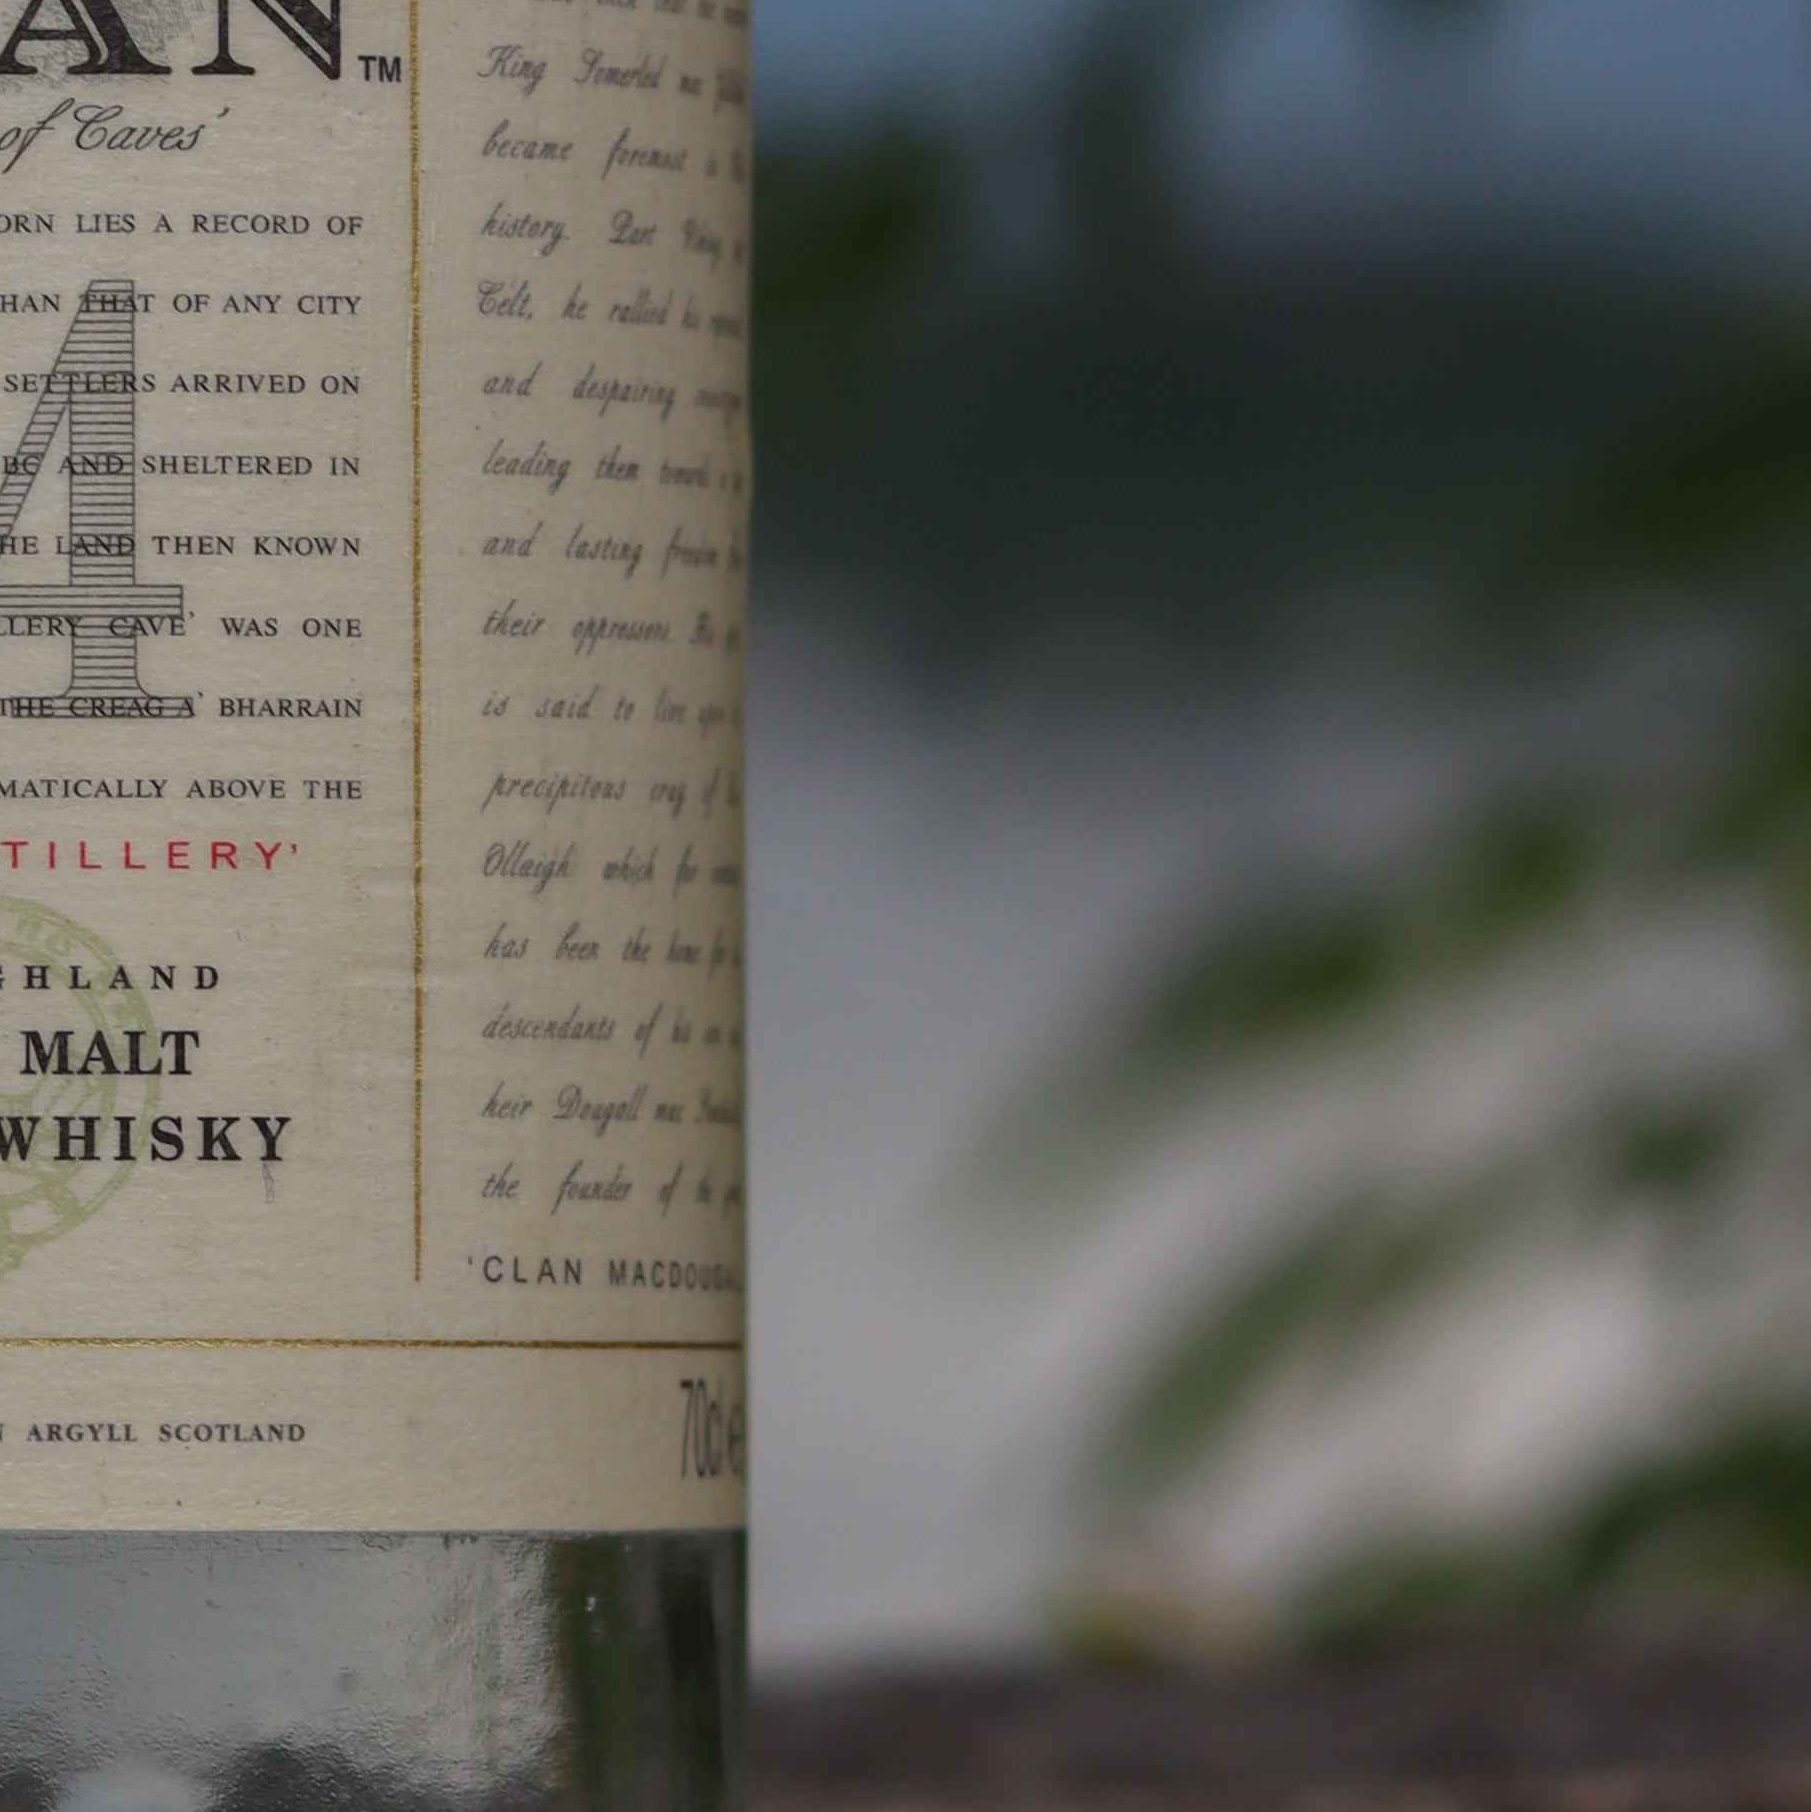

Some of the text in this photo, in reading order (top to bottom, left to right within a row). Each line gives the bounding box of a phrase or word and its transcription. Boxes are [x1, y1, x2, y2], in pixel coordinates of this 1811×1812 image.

[358, 55, 401, 82] TM
[478, 45, 547, 96] King
[482, 119, 574, 161] became
[76, 215, 135, 233] LIES
[153, 215, 173, 233] A
[192, 215, 310, 235] RECORD
[327, 216, 364, 235] OF
[608, 209, 656, 245] Part
[80, 294, 155, 313] THAT
[173, 294, 210, 313] OF
[222, 295, 281, 314] ANY
[298, 295, 362, 315] CITY
[561, 283, 588, 320] he
[3, 373, 155, 393] SETTLERS
[171, 375, 306, 393] ARRIVED
[321, 376, 360, 394] ON
[483, 361, 542, 398] and
[3, 455, 41, 475] BC
[59, 456, 124, 475] AND
[142, 456, 312, 475] SHELTERED
[331, 457, 360, 475] IN
[482, 439, 572, 495] leading
[595, 443, 639, 482] them
[57, 536, 135, 555] LAND
[153, 536, 235, 555] THEN
[254, 537, 360, 556] KNOWN
[482, 521, 643, 580] and lasting
[221, 618, 278, 637] WAS
[303, 619, 363, 638] ONE
[482, 599, 545, 637] their
[70, 697, 163, 718] CREAG
[220, 698, 363, 718] BHARRAIN
[482, 684, 635, 722] is said to
[186, 780, 286, 799] ABOVE
[304, 780, 363, 799] THE
[484, 923, 528, 958] has
[556, 922, 600, 961] been
[482, 1001, 663, 1059] descendants of
[20, 1030, 200, 1075] MALT
[482, 1081, 533, 1119] heir
[482, 1161, 519, 1199] the
[551, 1159, 632, 1215] founder
[27, 1423, 139, 1443] ARGYLL
[158, 1423, 306, 1443] SCOTLAND
